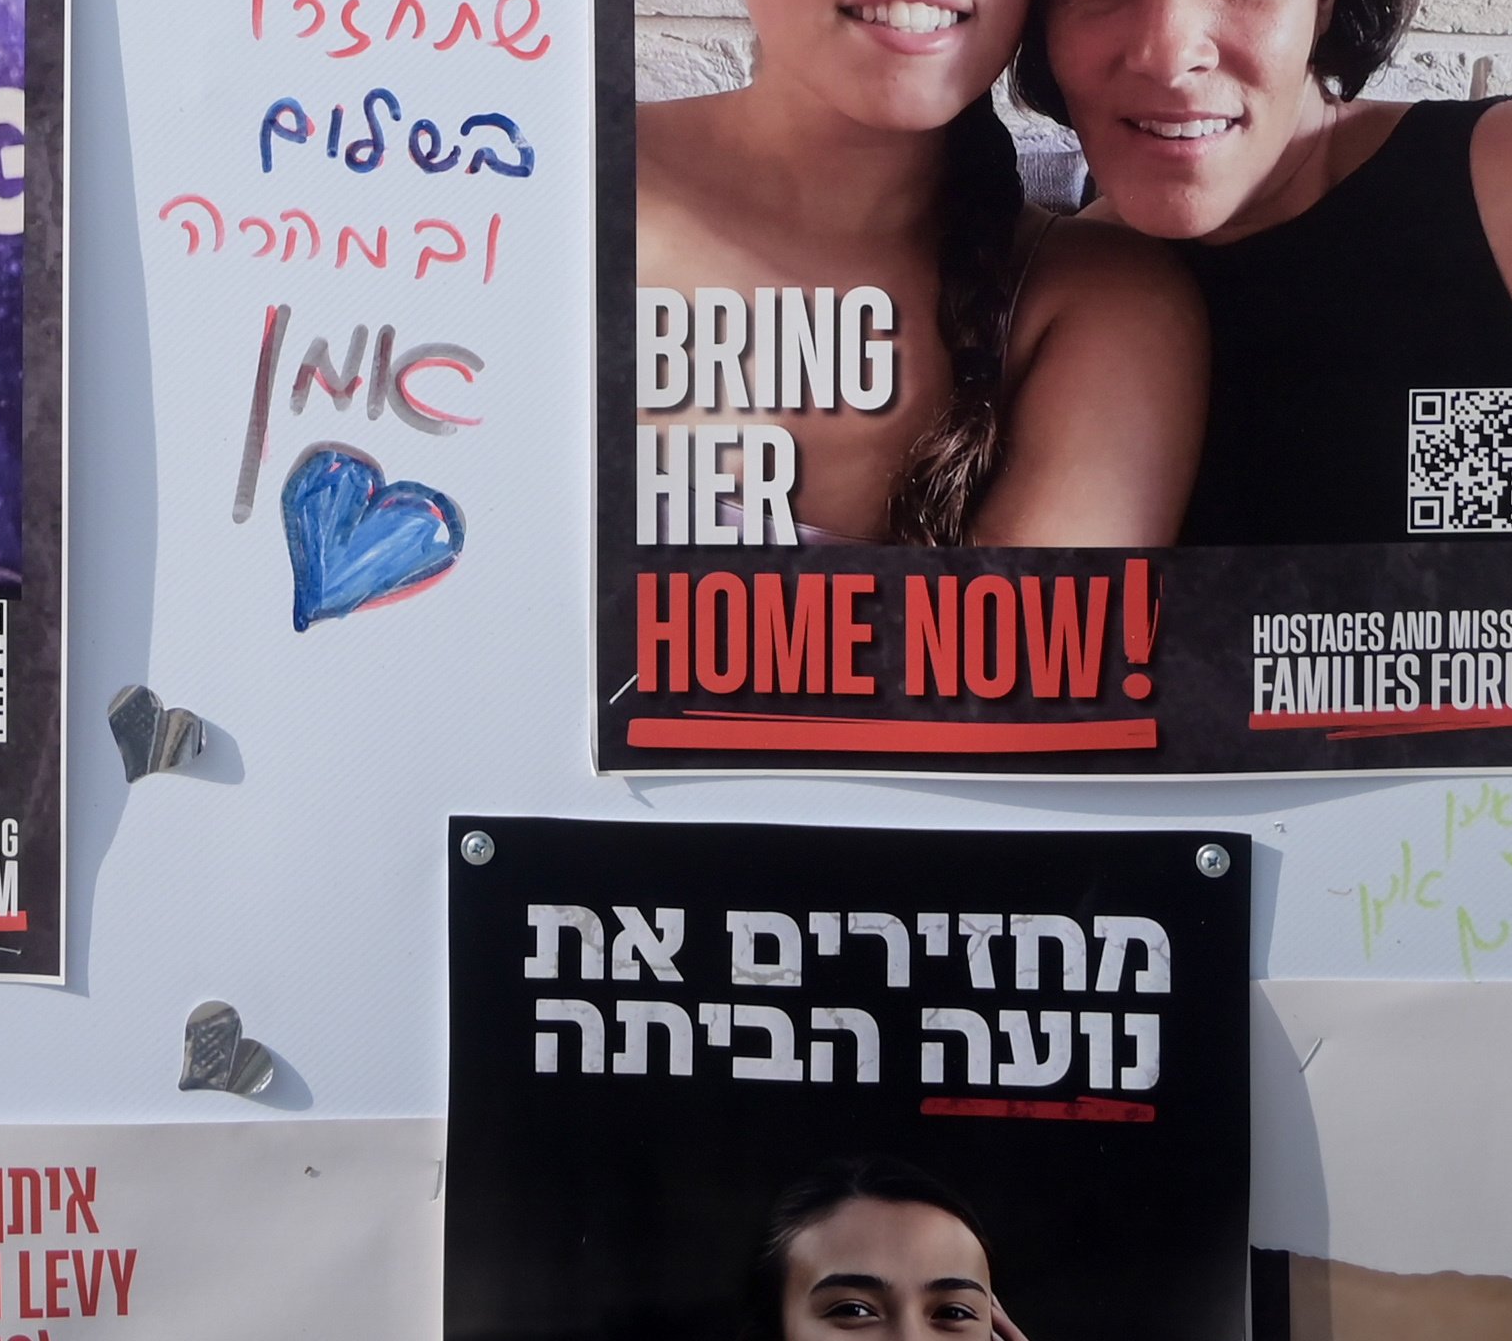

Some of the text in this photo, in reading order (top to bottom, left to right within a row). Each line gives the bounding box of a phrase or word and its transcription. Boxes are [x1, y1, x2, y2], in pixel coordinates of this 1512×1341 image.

[260, 88, 538, 183] בשלום
[158, 194, 500, 285] ובמהרה
[232, 302, 487, 525] אמן
[1254, 612, 1384, 654] HOSTAGES
[1390, 611, 1442, 650] AND
[1254, 654, 1419, 715] FAMILIES
[525, 905, 1170, 993] מחזירים את
[536, 999, 1159, 1090] נועה הביתה
[20, 1250, 137, 1319] LEVY
